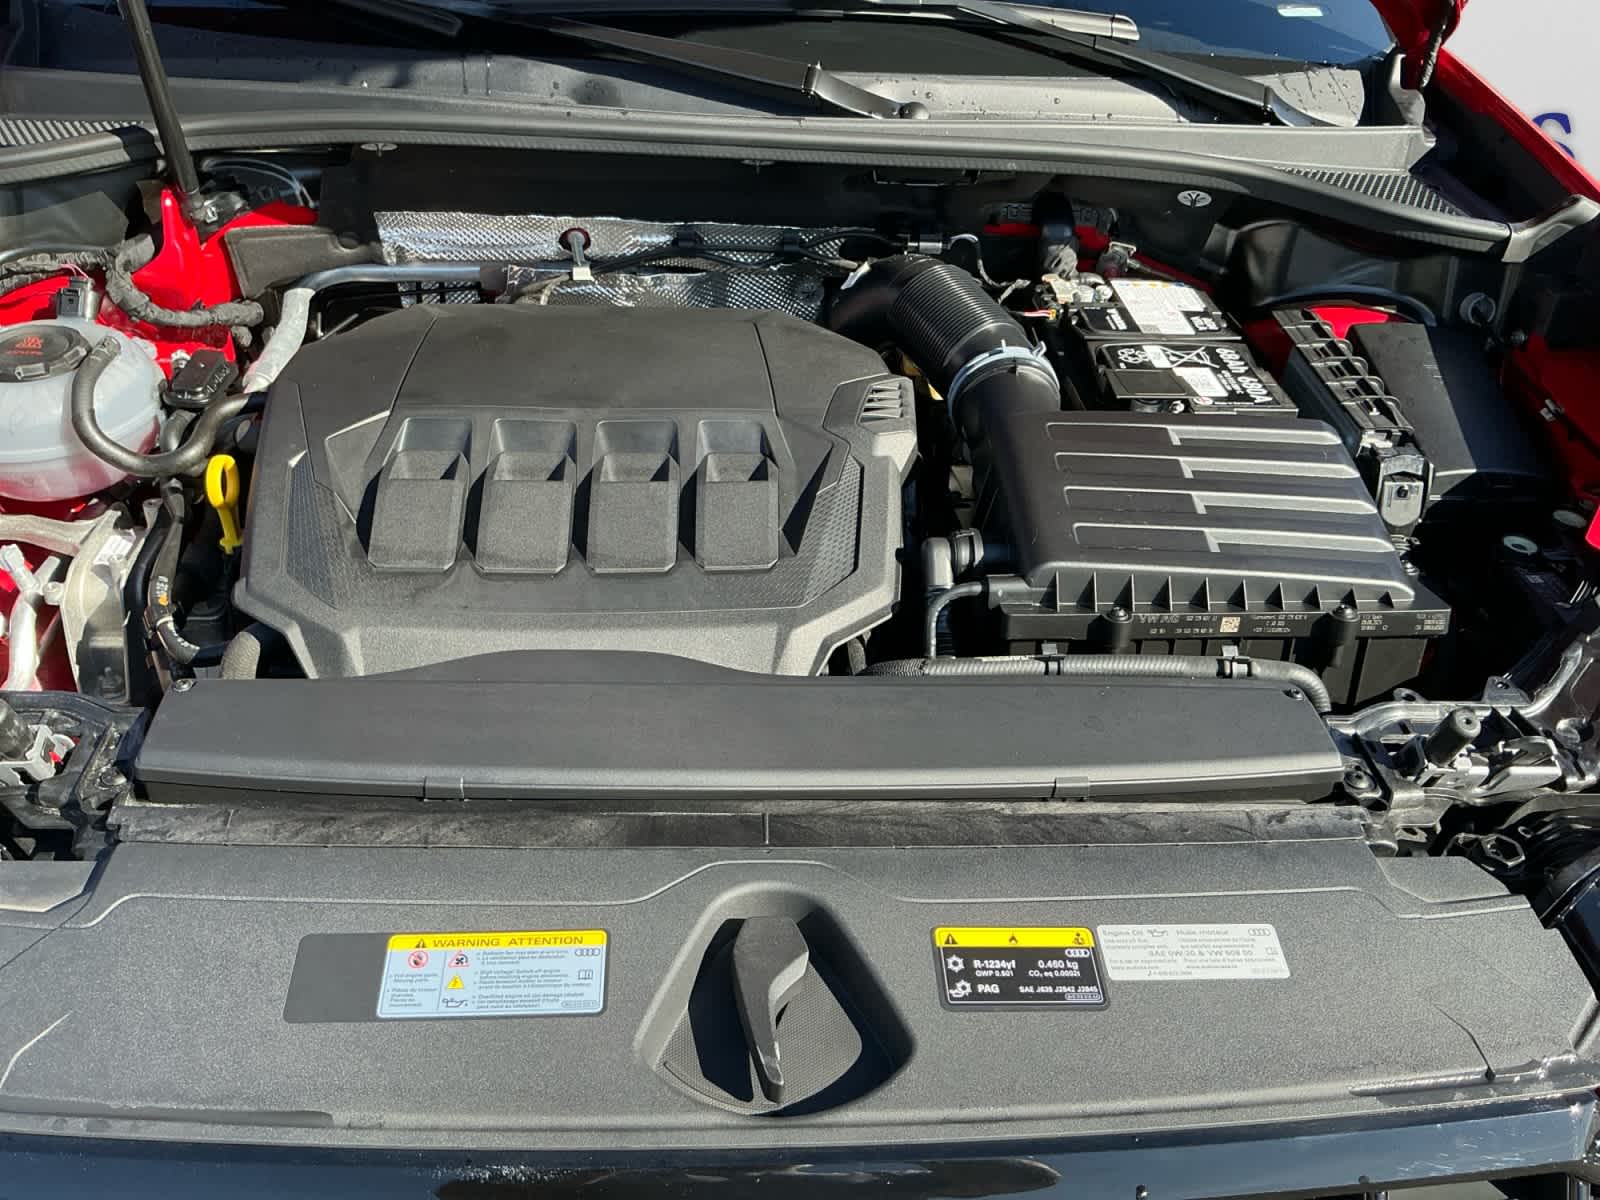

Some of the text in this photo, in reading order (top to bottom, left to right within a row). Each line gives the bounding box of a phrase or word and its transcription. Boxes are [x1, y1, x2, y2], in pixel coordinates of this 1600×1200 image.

[1215, 347, 1249, 373] 68Ah
[1236, 376, 1273, 403] 680A
[432, 936, 584, 948] WARNING ATTENTION
[973, 959, 1016, 969] R-1234yf
[1066, 959, 1079, 970] kg
[977, 983, 1001, 993] PAG
